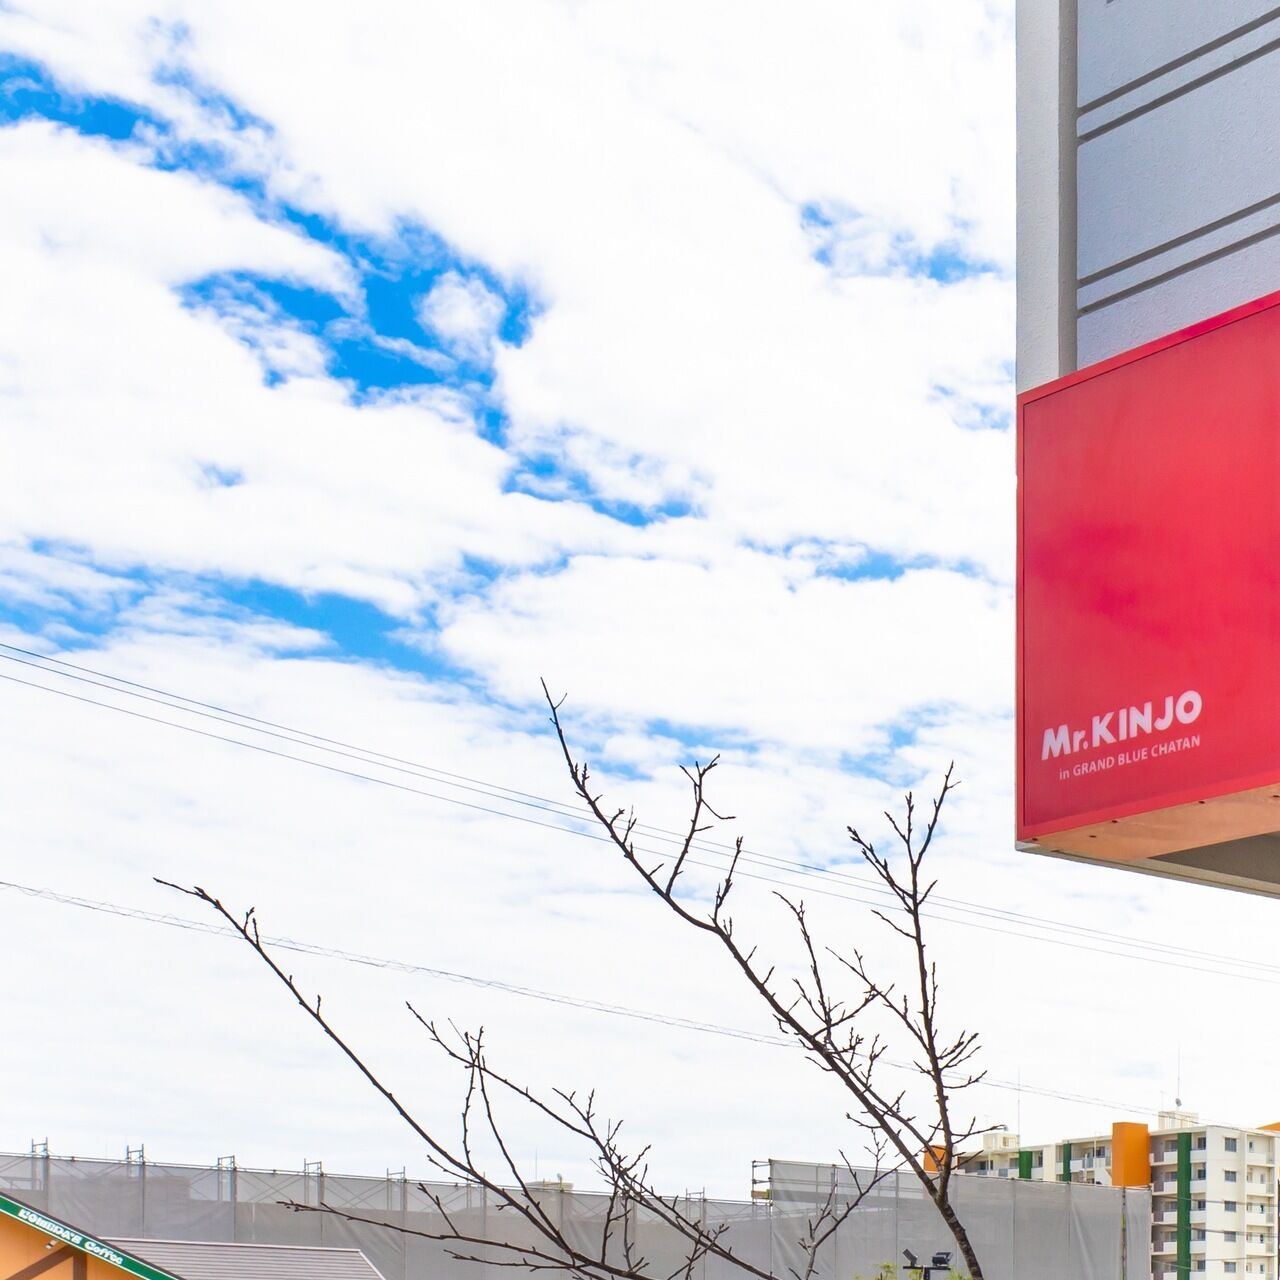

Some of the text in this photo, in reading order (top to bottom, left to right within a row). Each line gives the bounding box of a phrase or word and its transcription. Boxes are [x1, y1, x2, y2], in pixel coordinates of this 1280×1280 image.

[1059, 735, 1201, 780] in GRAND BLUE CHATAN
[84, 1240, 124, 1265] Coffee
